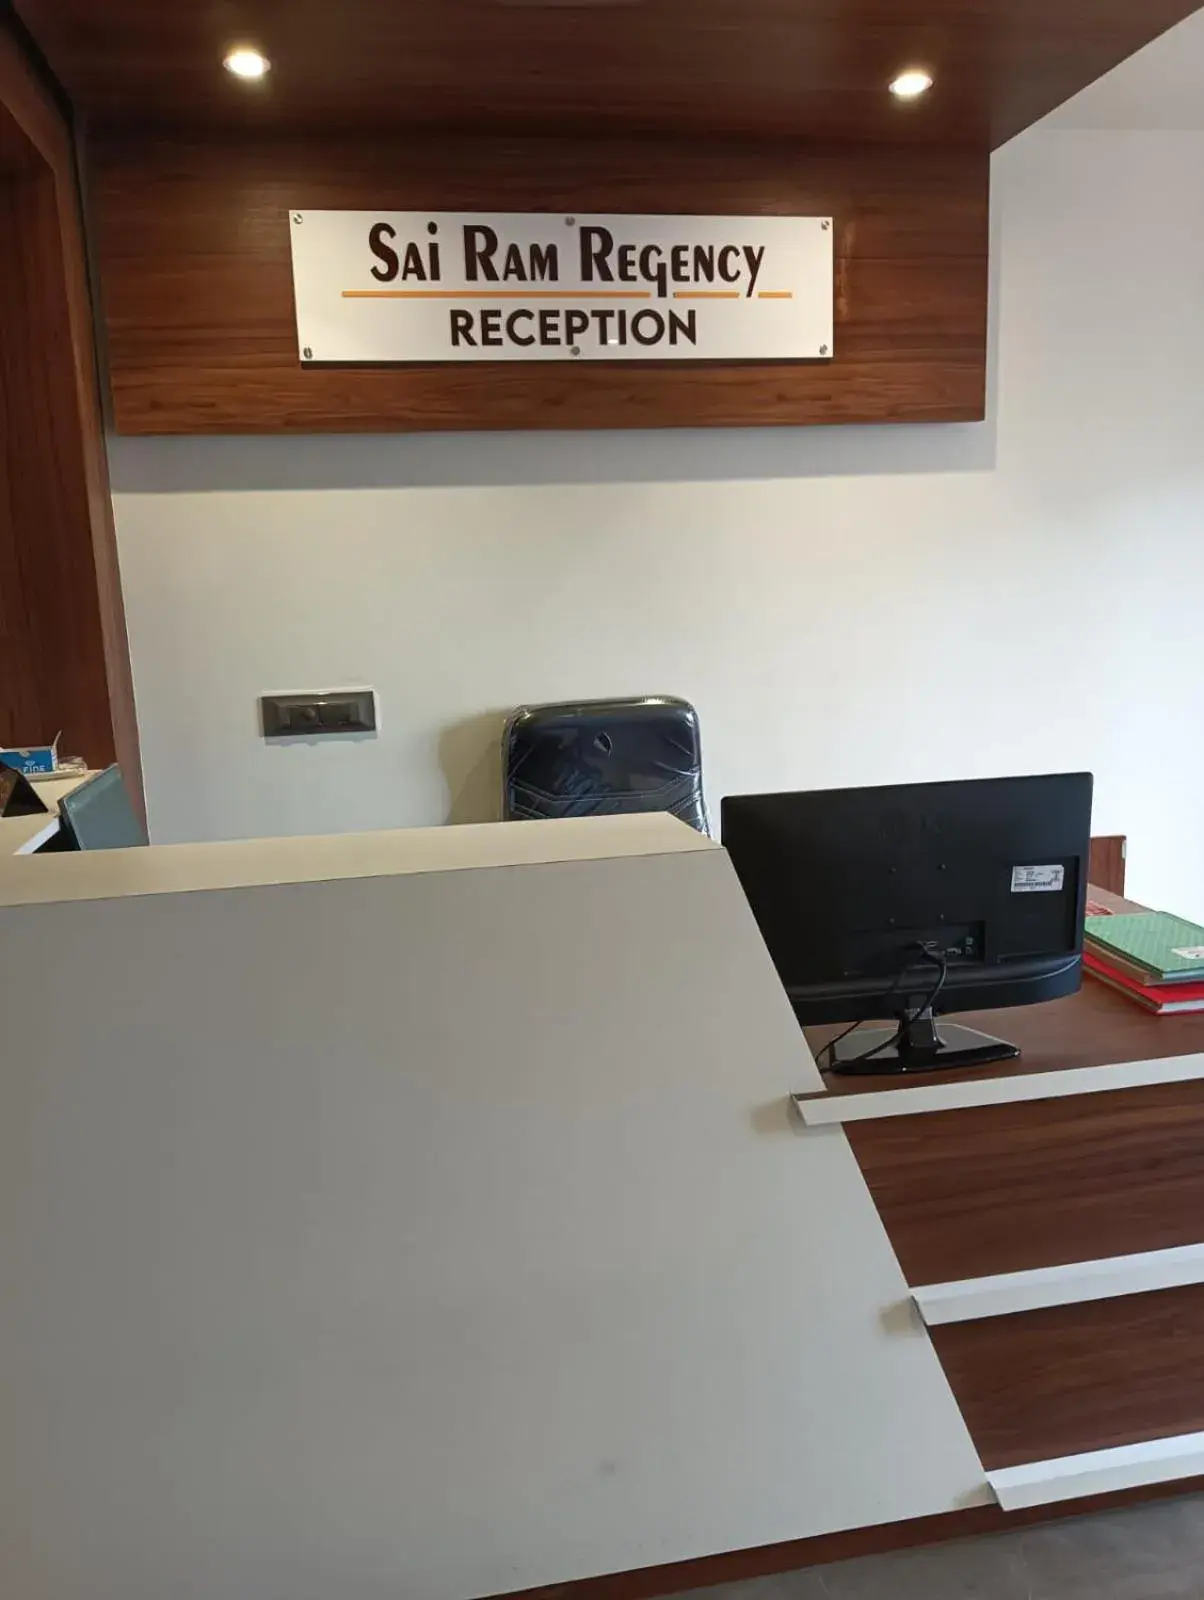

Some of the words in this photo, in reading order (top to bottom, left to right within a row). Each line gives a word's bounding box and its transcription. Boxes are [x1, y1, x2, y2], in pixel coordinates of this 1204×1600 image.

[463, 224, 558, 282] RAM
[579, 226, 764, 298] REGENCY
[450, 309, 696, 346] RECEPTION
